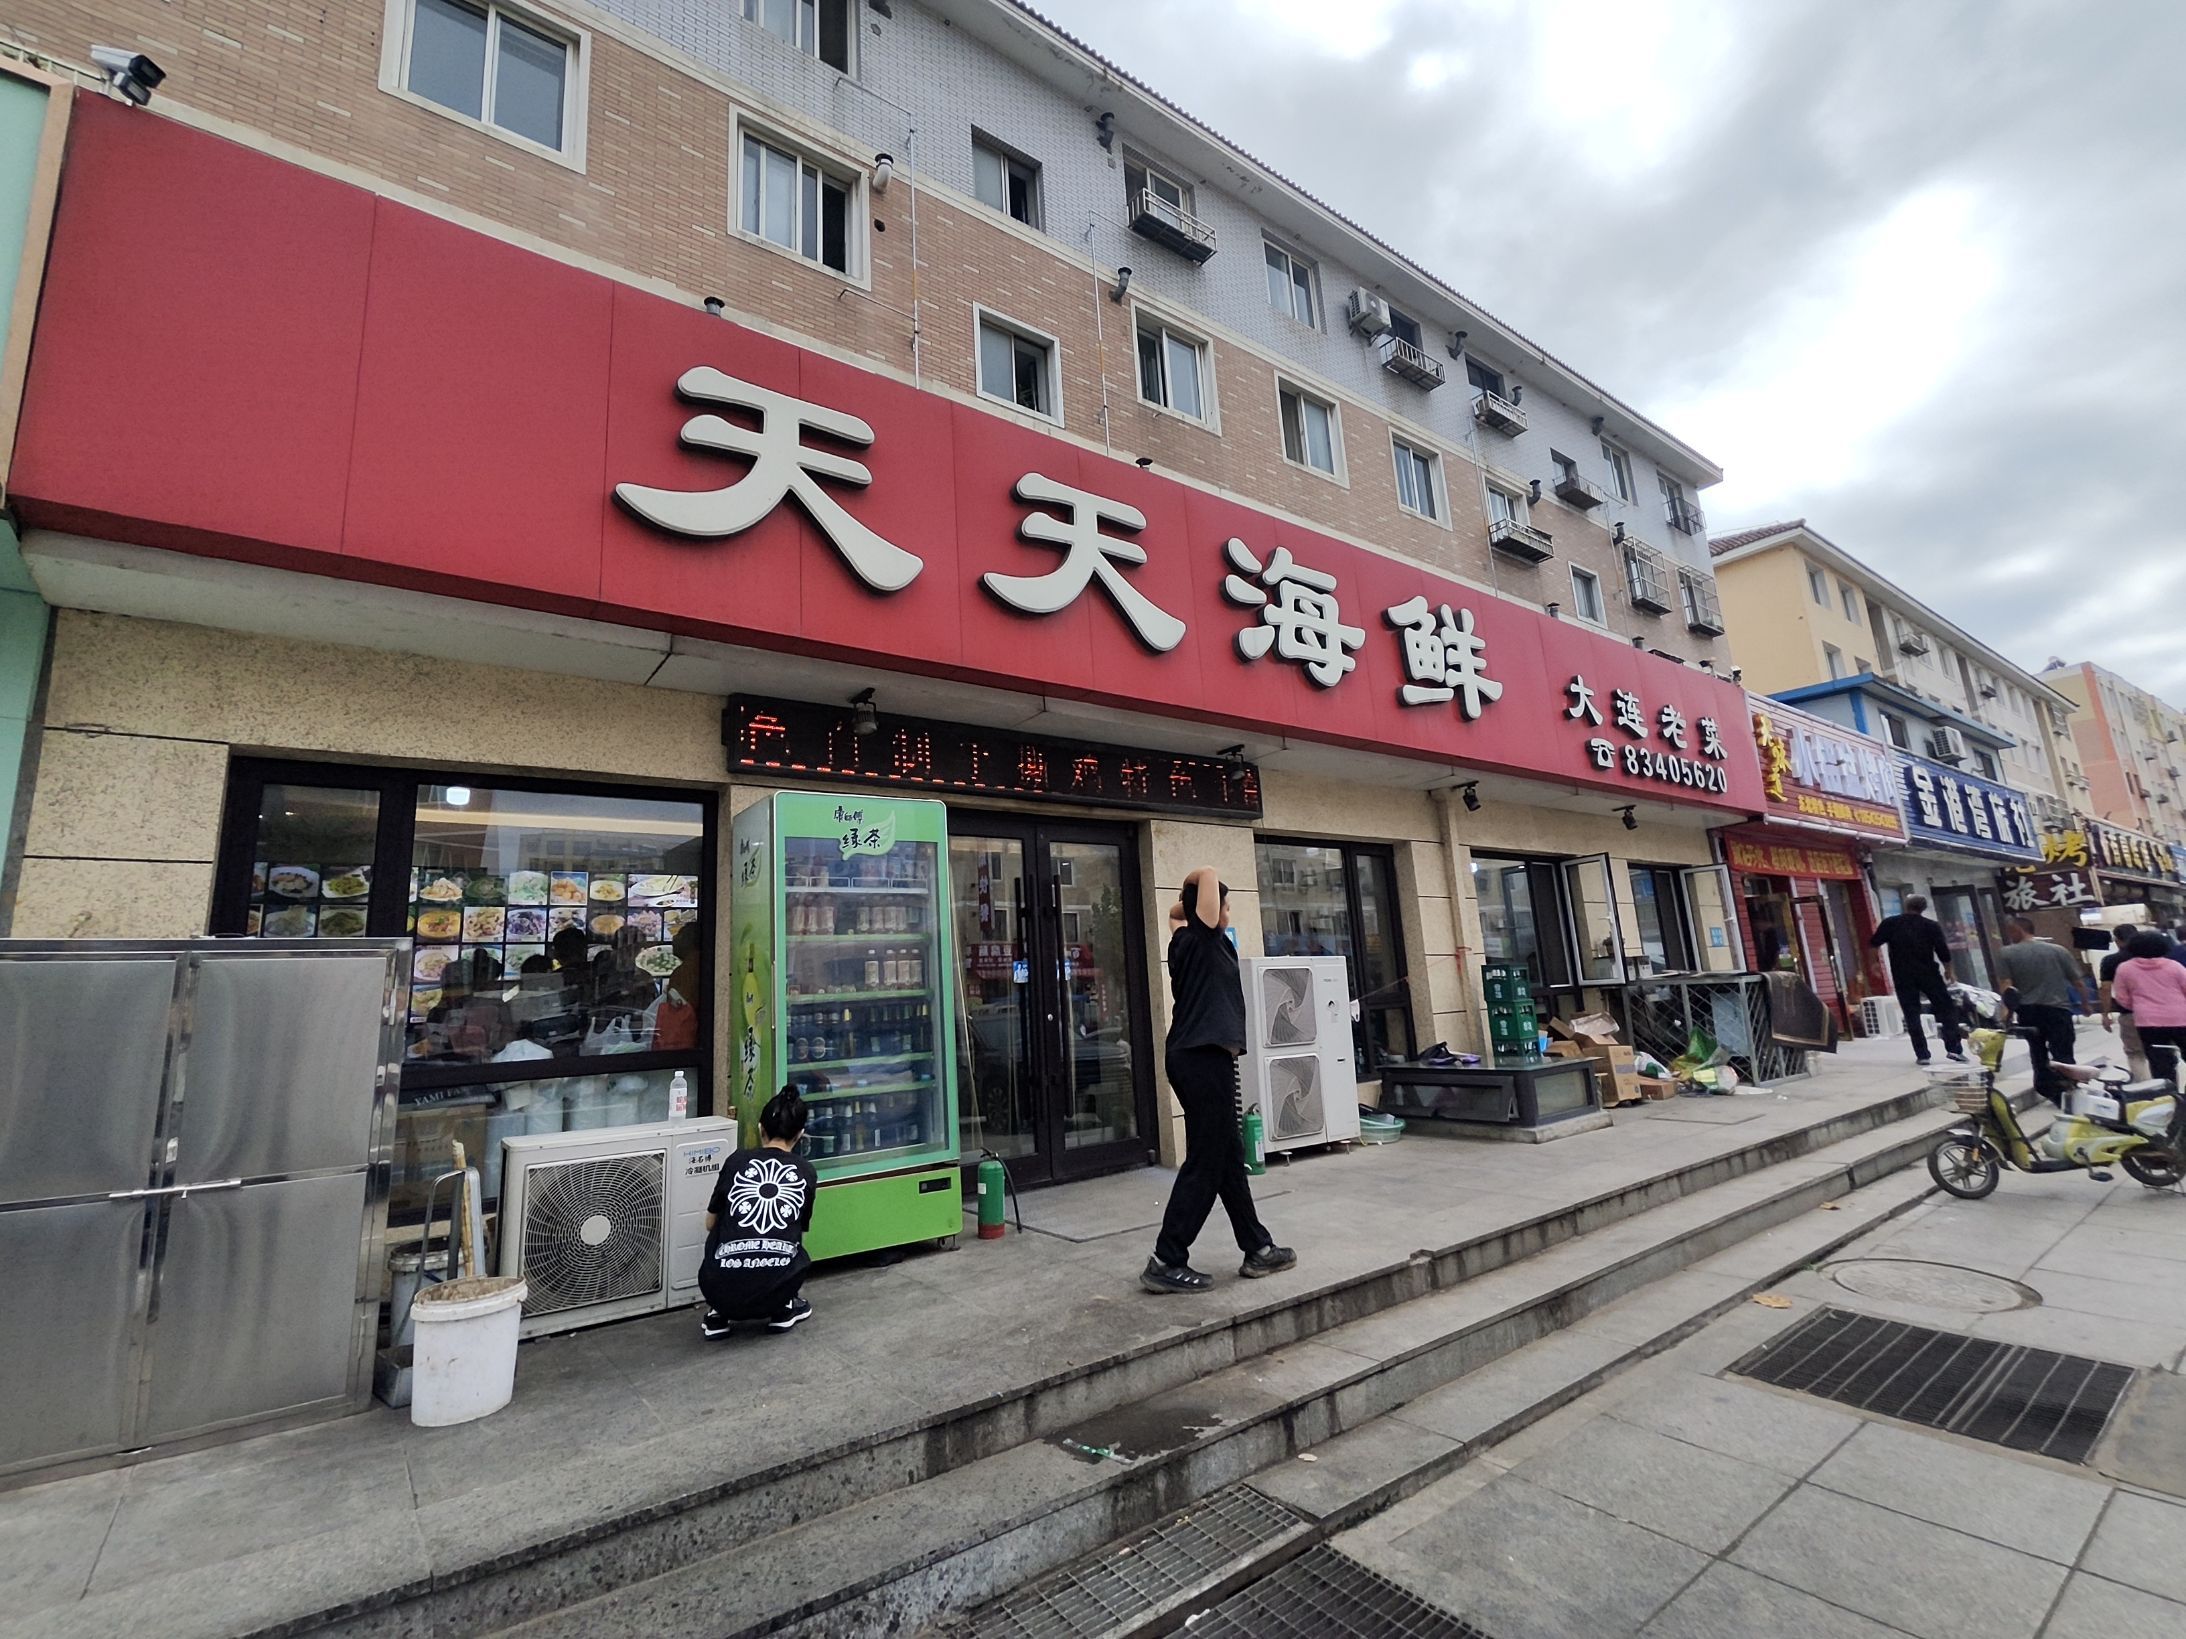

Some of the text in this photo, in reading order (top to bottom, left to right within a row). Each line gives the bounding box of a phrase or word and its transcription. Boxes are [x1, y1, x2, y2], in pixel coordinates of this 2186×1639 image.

[615, 366, 1503, 720] 天天海鲜
[1566, 674, 1728, 760] 大连老菜
[1623, 744, 1728, 793] 83405620
[842, 828, 880, 849] 绿茶
[2003, 871, 2097, 910] 旅社
